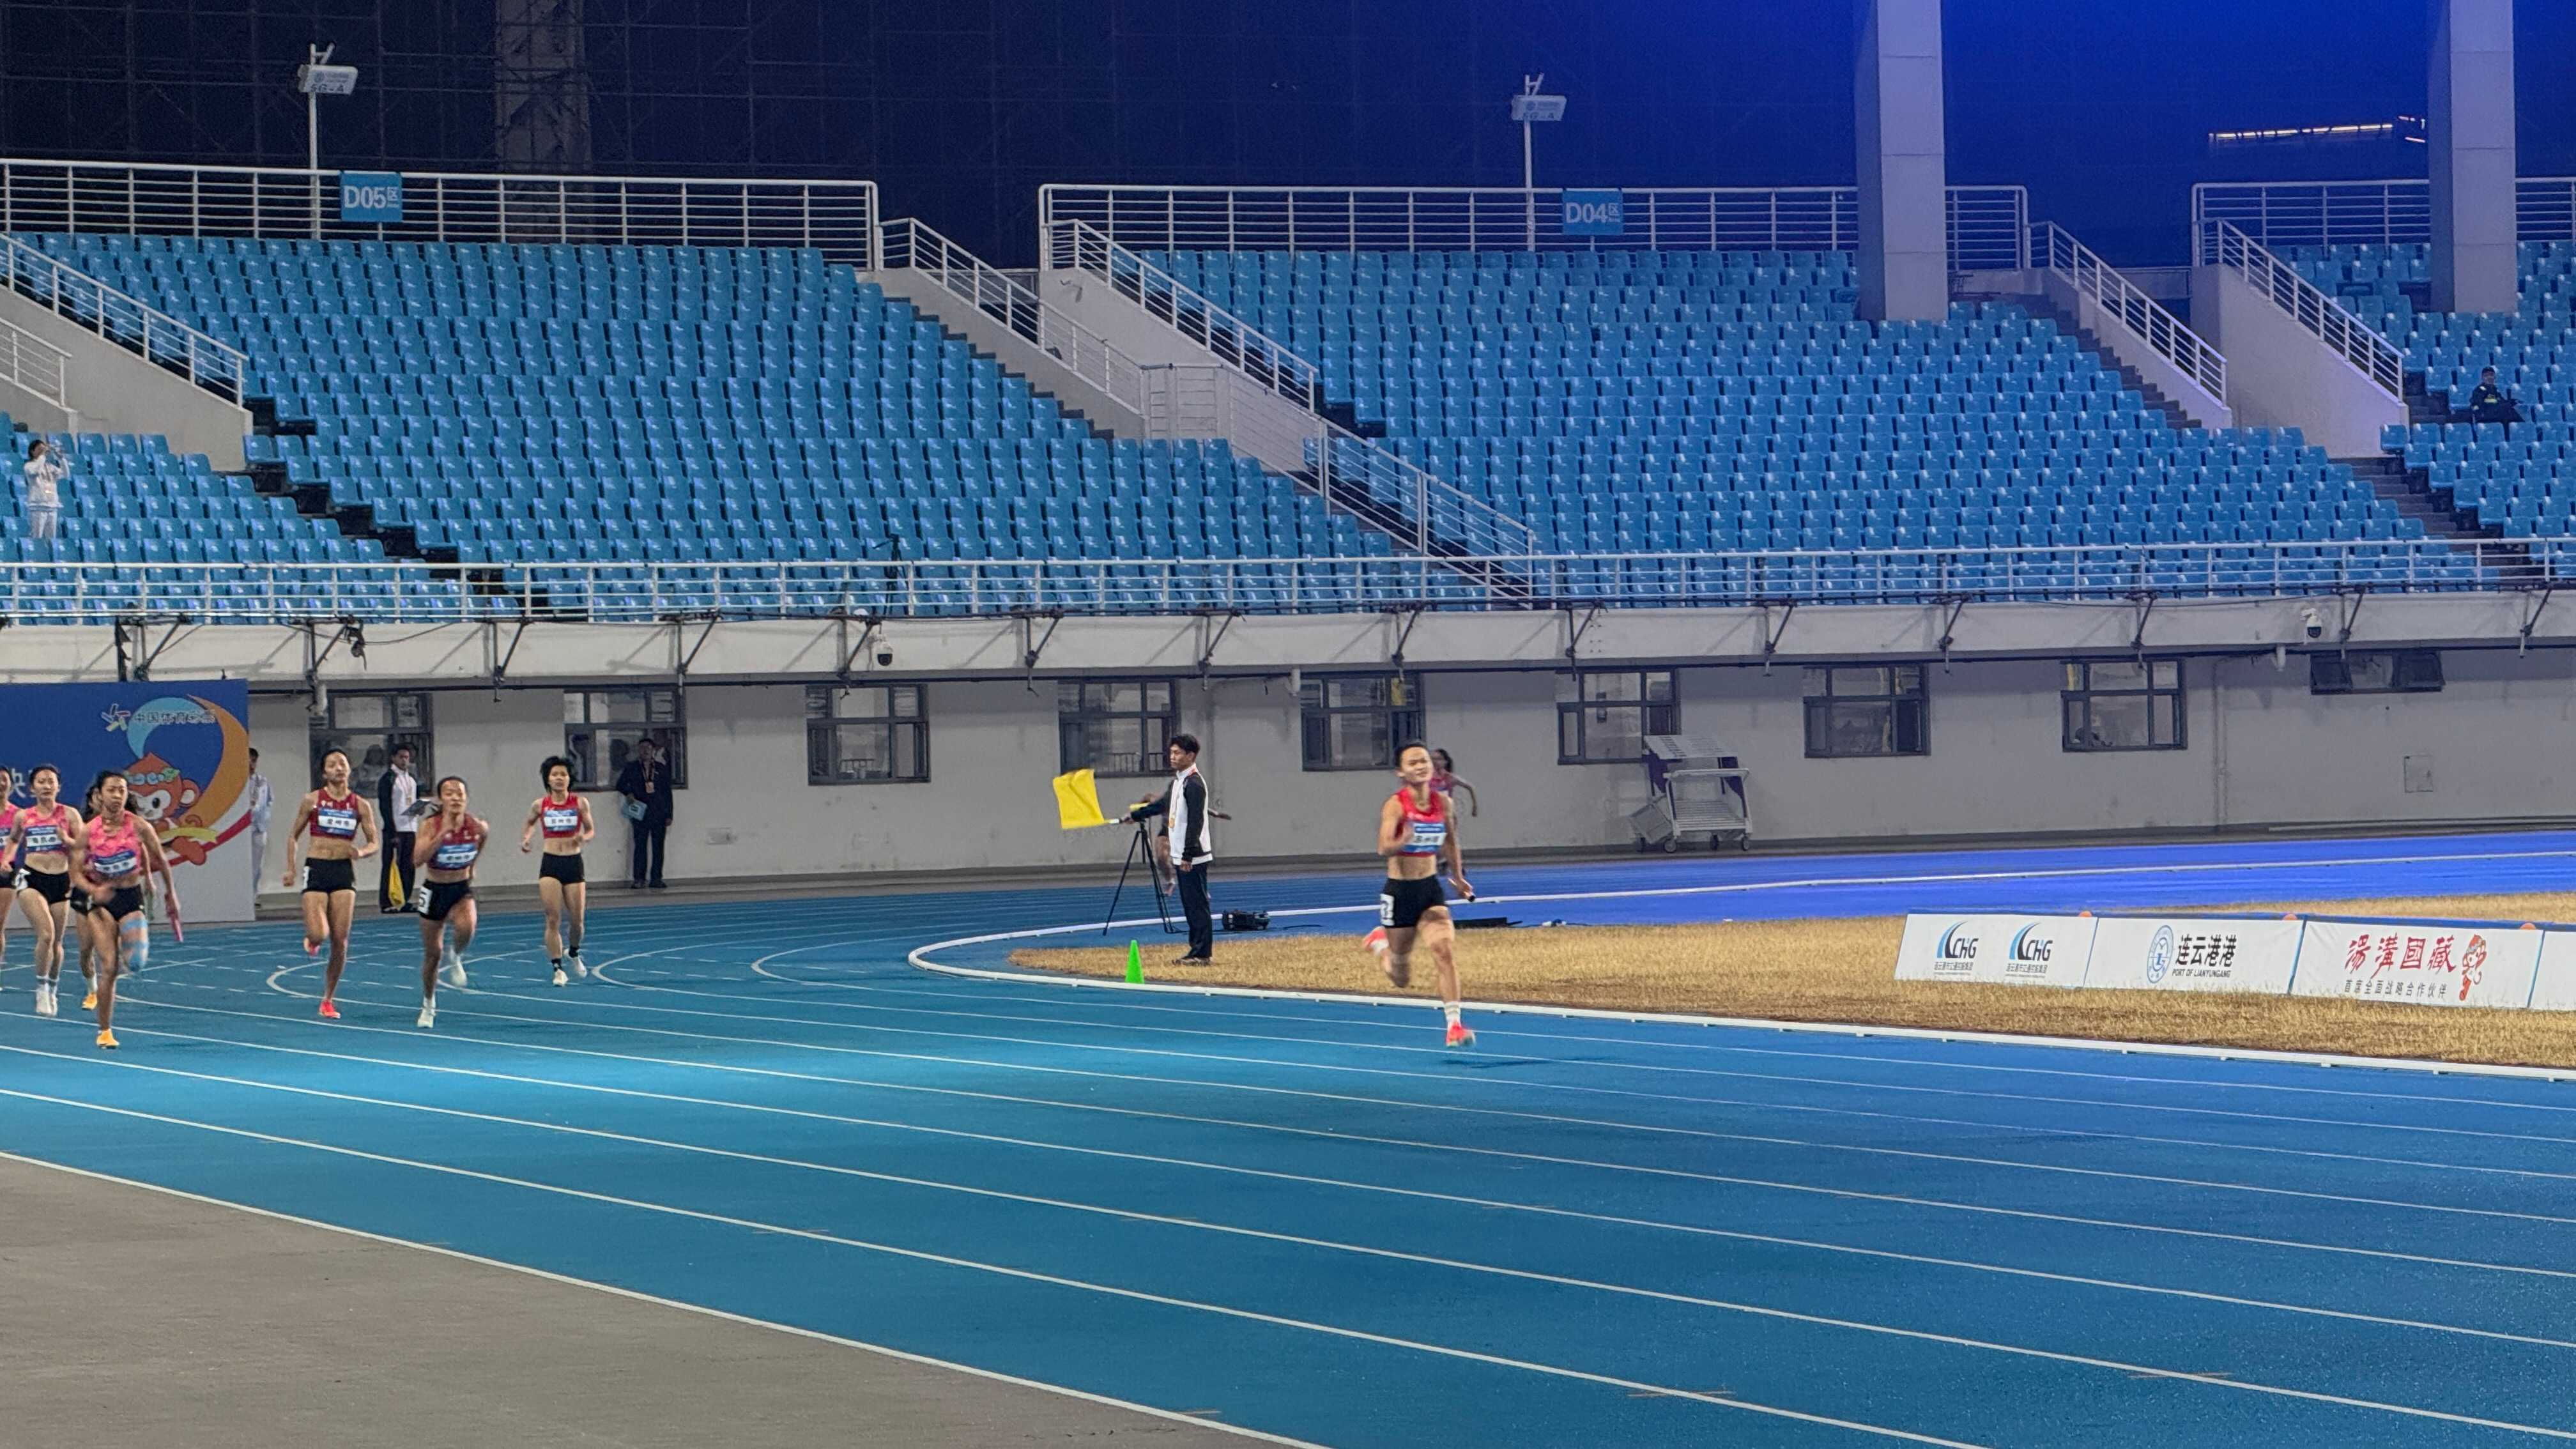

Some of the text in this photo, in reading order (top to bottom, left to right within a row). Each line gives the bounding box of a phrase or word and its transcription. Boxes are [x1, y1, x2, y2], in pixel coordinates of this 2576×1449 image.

[2175, 933, 2237, 967] 连云港港
[2172, 969, 2232, 977] PORT OF LIANYUNGANG
